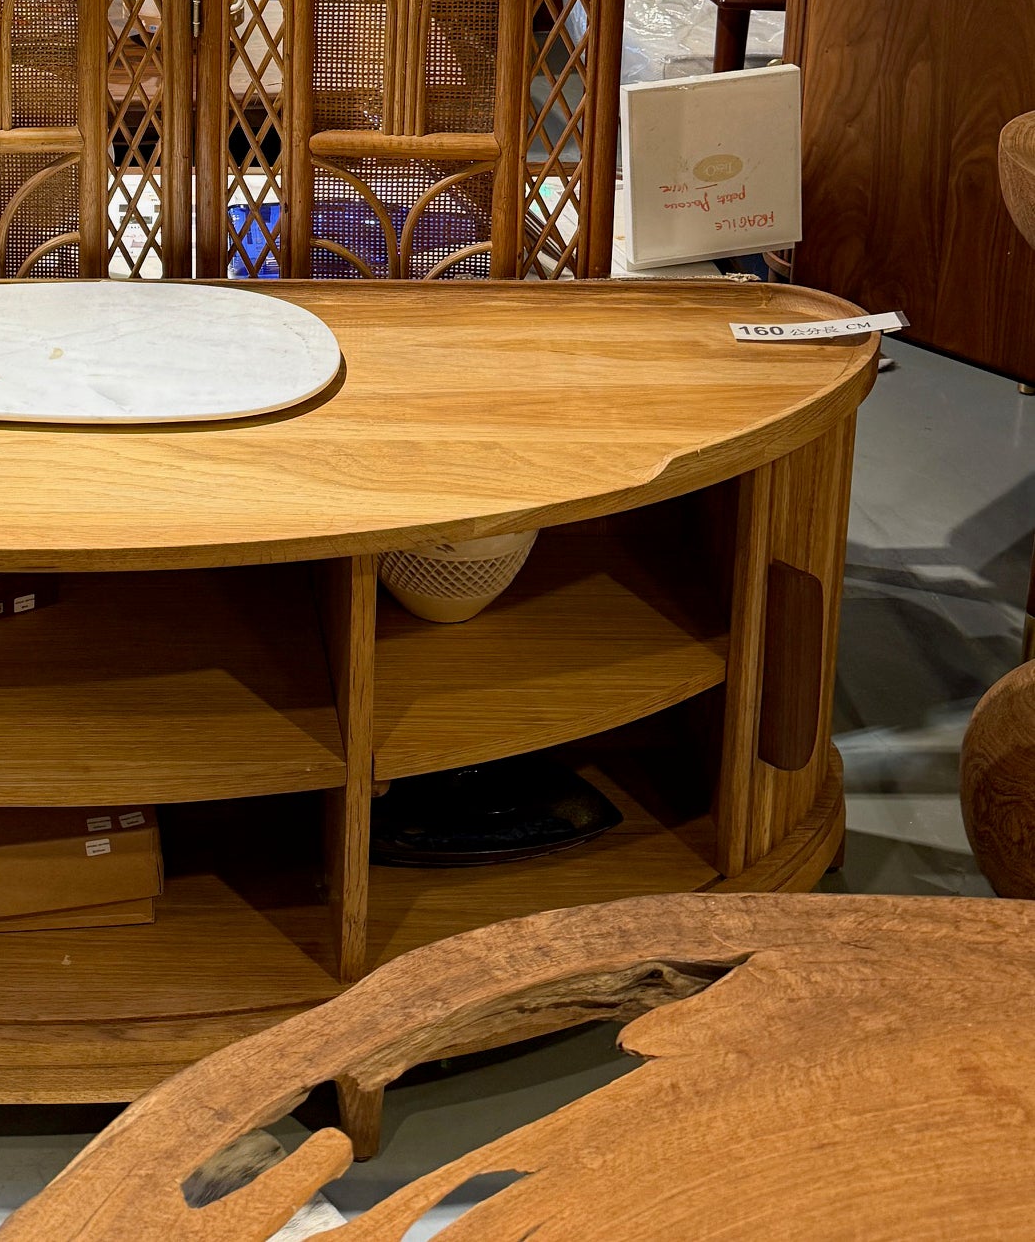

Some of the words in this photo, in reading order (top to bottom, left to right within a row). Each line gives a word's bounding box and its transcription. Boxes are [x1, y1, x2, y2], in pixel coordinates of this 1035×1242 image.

[714, 211, 775, 232] FRAGILE
[739, 325, 785, 336] 160
[845, 321, 872, 331] CM
